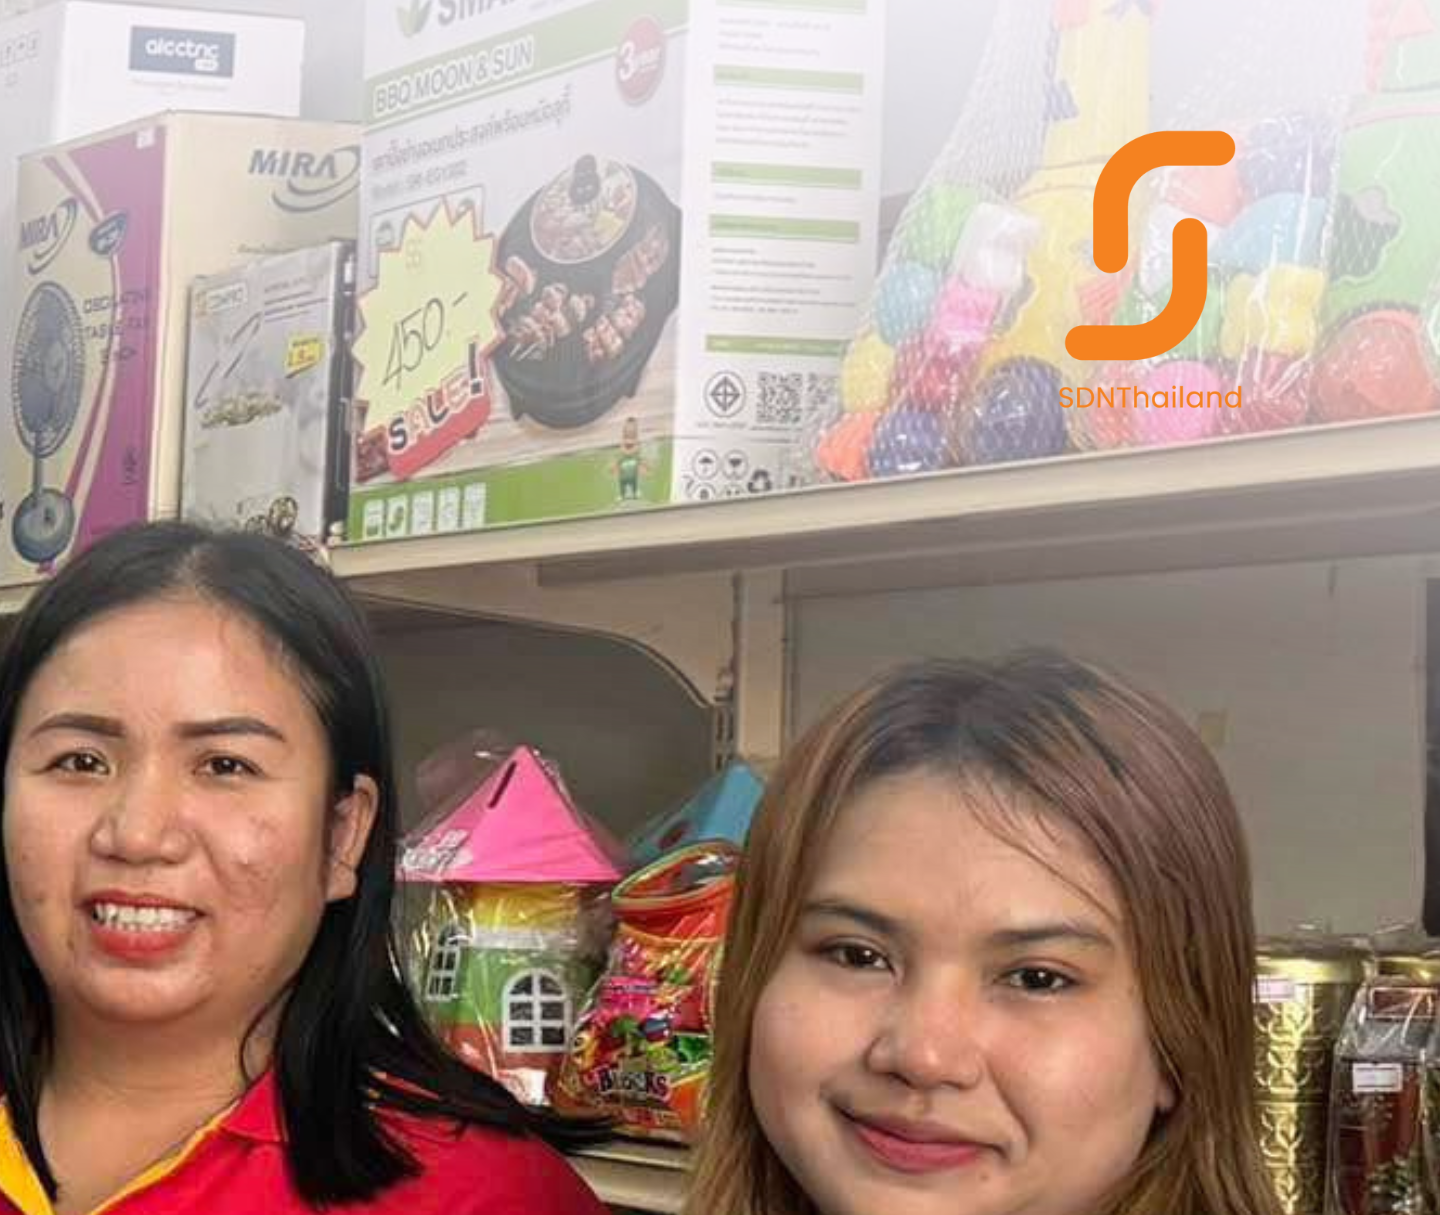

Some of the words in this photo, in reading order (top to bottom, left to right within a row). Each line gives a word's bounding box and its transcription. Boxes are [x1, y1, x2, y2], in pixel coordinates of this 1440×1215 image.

[373, 82, 410, 115] BBQ
[415, 65, 472, 102] MOON
[475, 55, 489, 80] &
[492, 36, 535, 77] SUN
[619, 41, 638, 80] 3
[248, 148, 338, 180] MIRA
[20, 211, 60, 249] MIRA
[386, 341, 487, 454] SALE!
